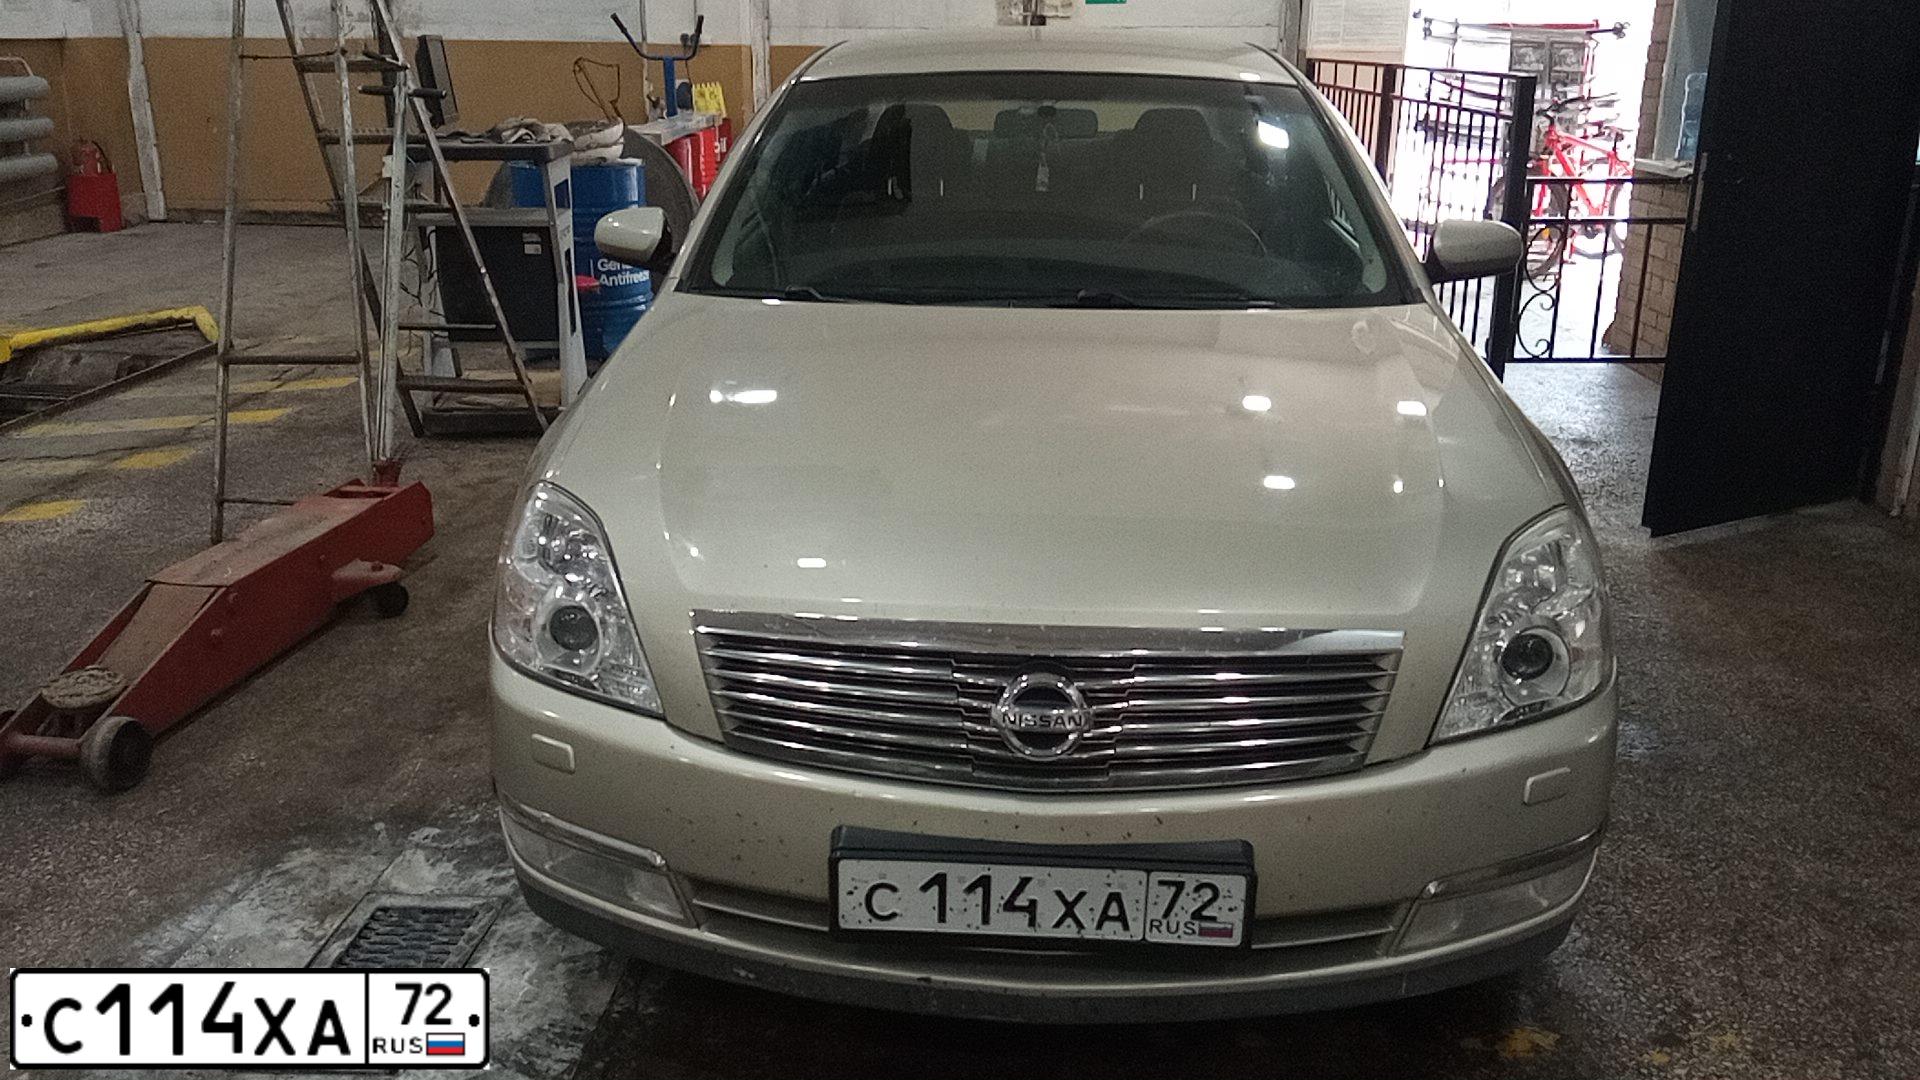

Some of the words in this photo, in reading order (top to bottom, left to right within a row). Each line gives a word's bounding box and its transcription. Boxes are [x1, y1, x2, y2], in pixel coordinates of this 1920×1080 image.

[1002, 713, 1083, 728] NISSAN
[1157, 879, 1220, 922] 72
[1150, 918, 1197, 937] RUS
